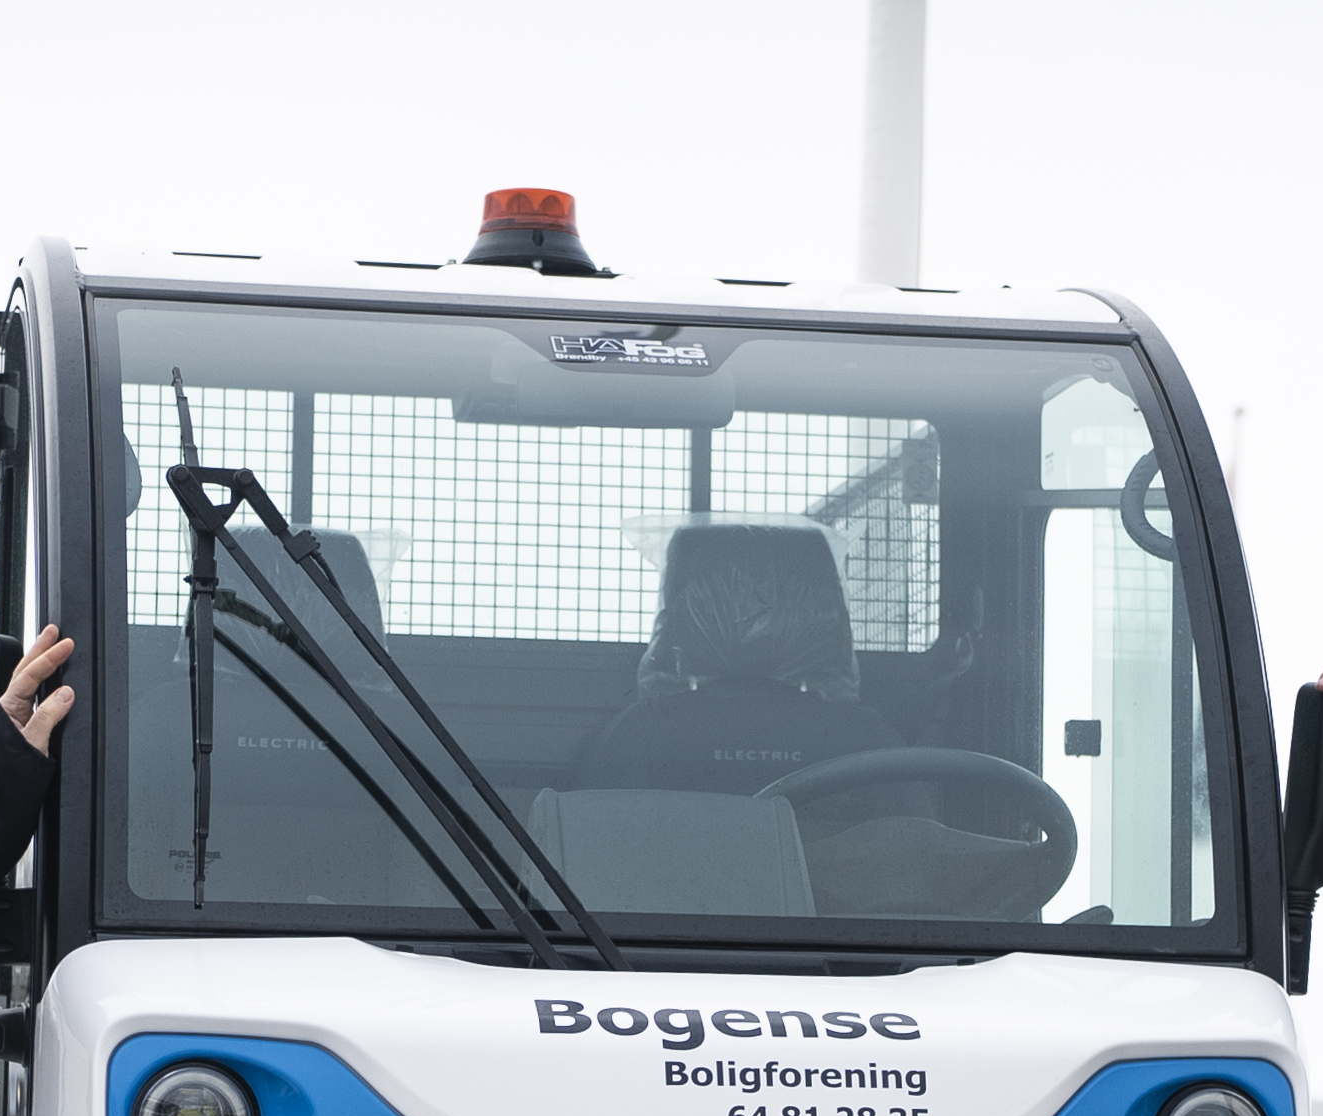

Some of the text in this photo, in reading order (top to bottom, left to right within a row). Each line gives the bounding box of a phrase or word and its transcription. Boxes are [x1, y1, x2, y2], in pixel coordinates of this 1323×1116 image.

[237, 736, 329, 751] ELECTRIC
[714, 750, 801, 761] ELECTRIC
[534, 999, 921, 1051] Bogense
[664, 1060, 927, 1096] Boligforening
